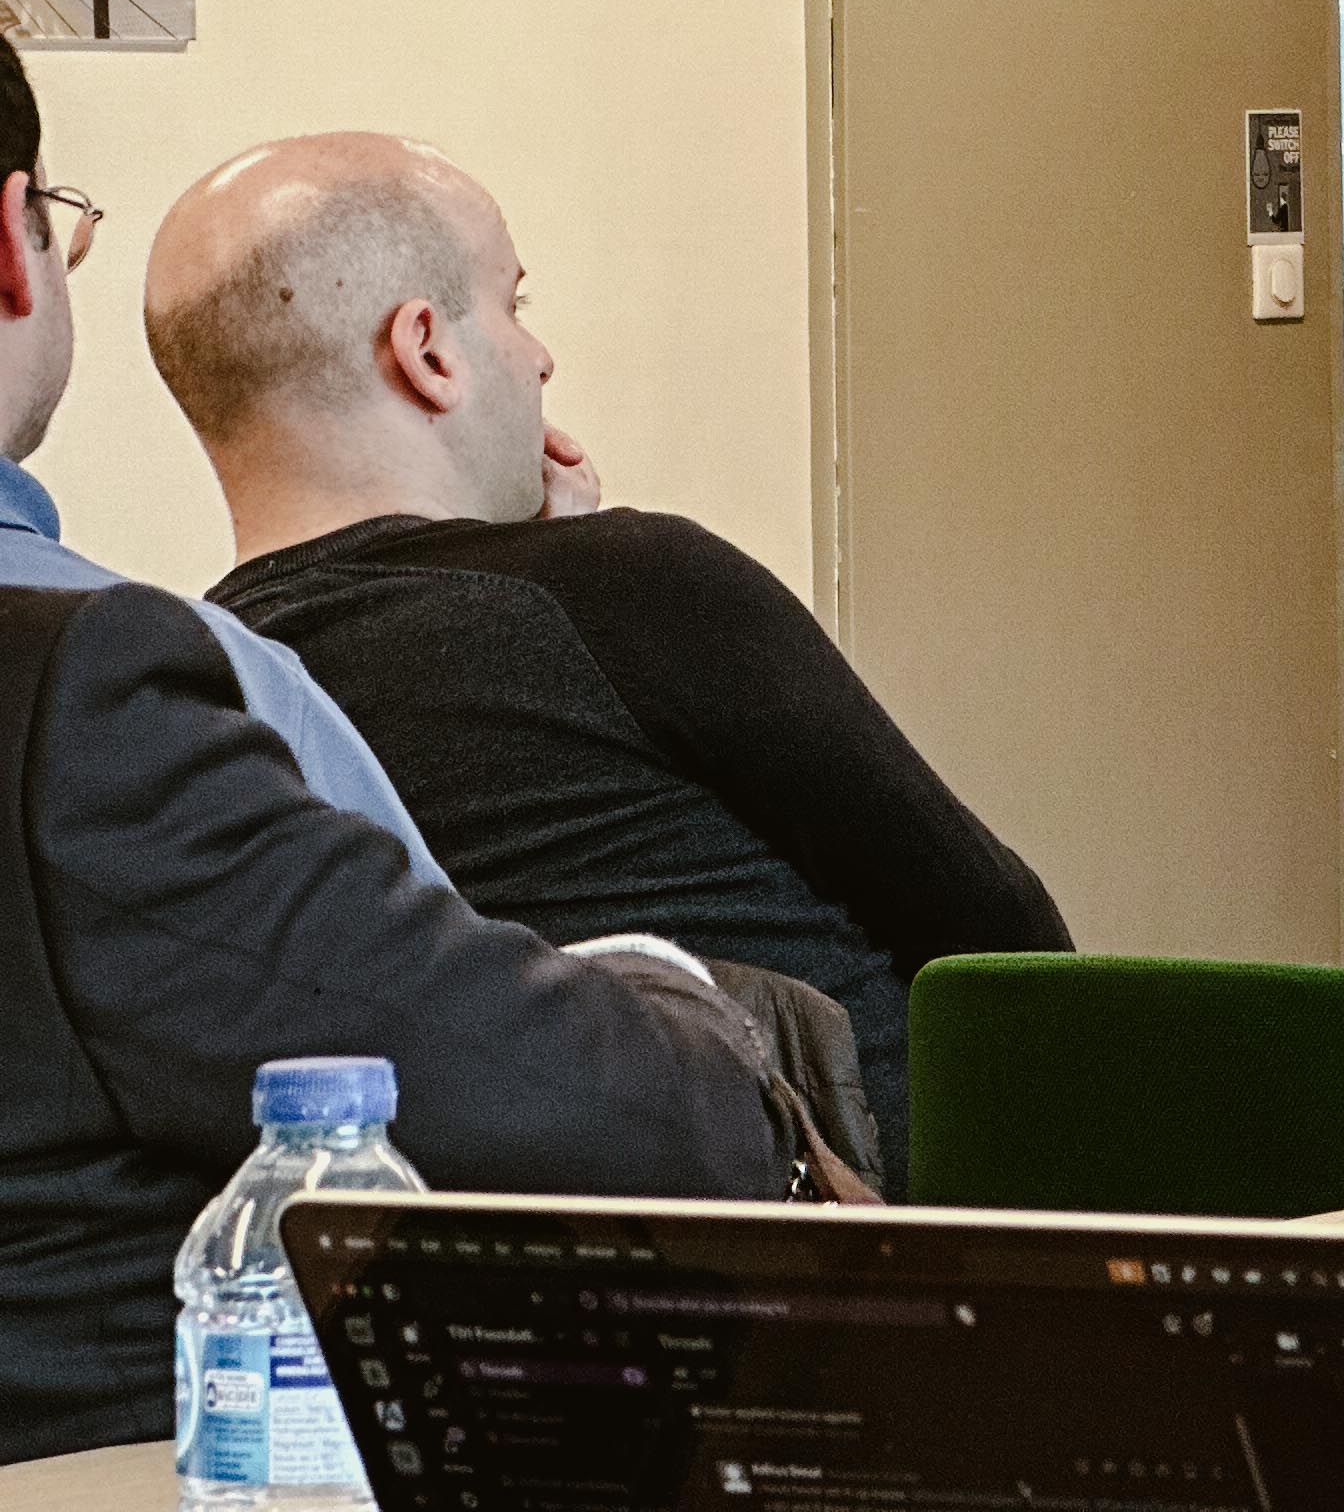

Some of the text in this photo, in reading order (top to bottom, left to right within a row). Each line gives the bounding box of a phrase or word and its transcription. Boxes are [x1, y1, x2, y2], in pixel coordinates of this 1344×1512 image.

[1268, 125, 1299, 138] PLEASE
[1267, 138, 1299, 151] SWITCH
[1283, 151, 1300, 164] OFF
